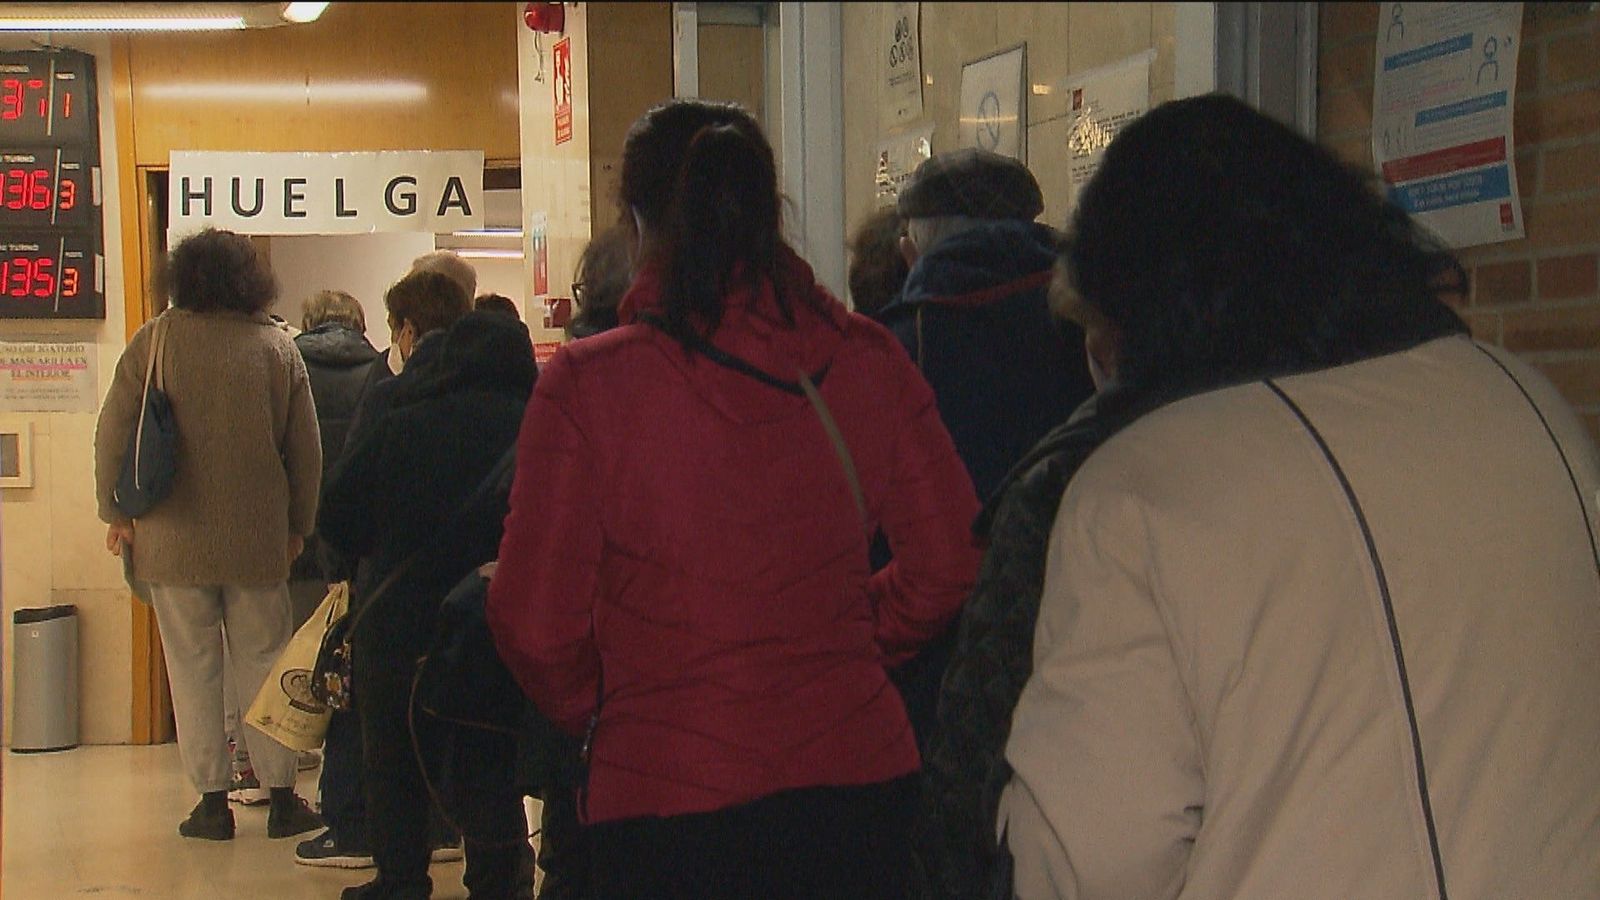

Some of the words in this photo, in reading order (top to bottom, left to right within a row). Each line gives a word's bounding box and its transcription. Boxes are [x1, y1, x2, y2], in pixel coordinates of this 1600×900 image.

[63, 92, 71, 118] 1
[60, 179, 75, 210] 3
[180, 176, 473, 218] HUELGA
[1, 258, 54, 297] 135
[62, 268, 78, 297] 3
